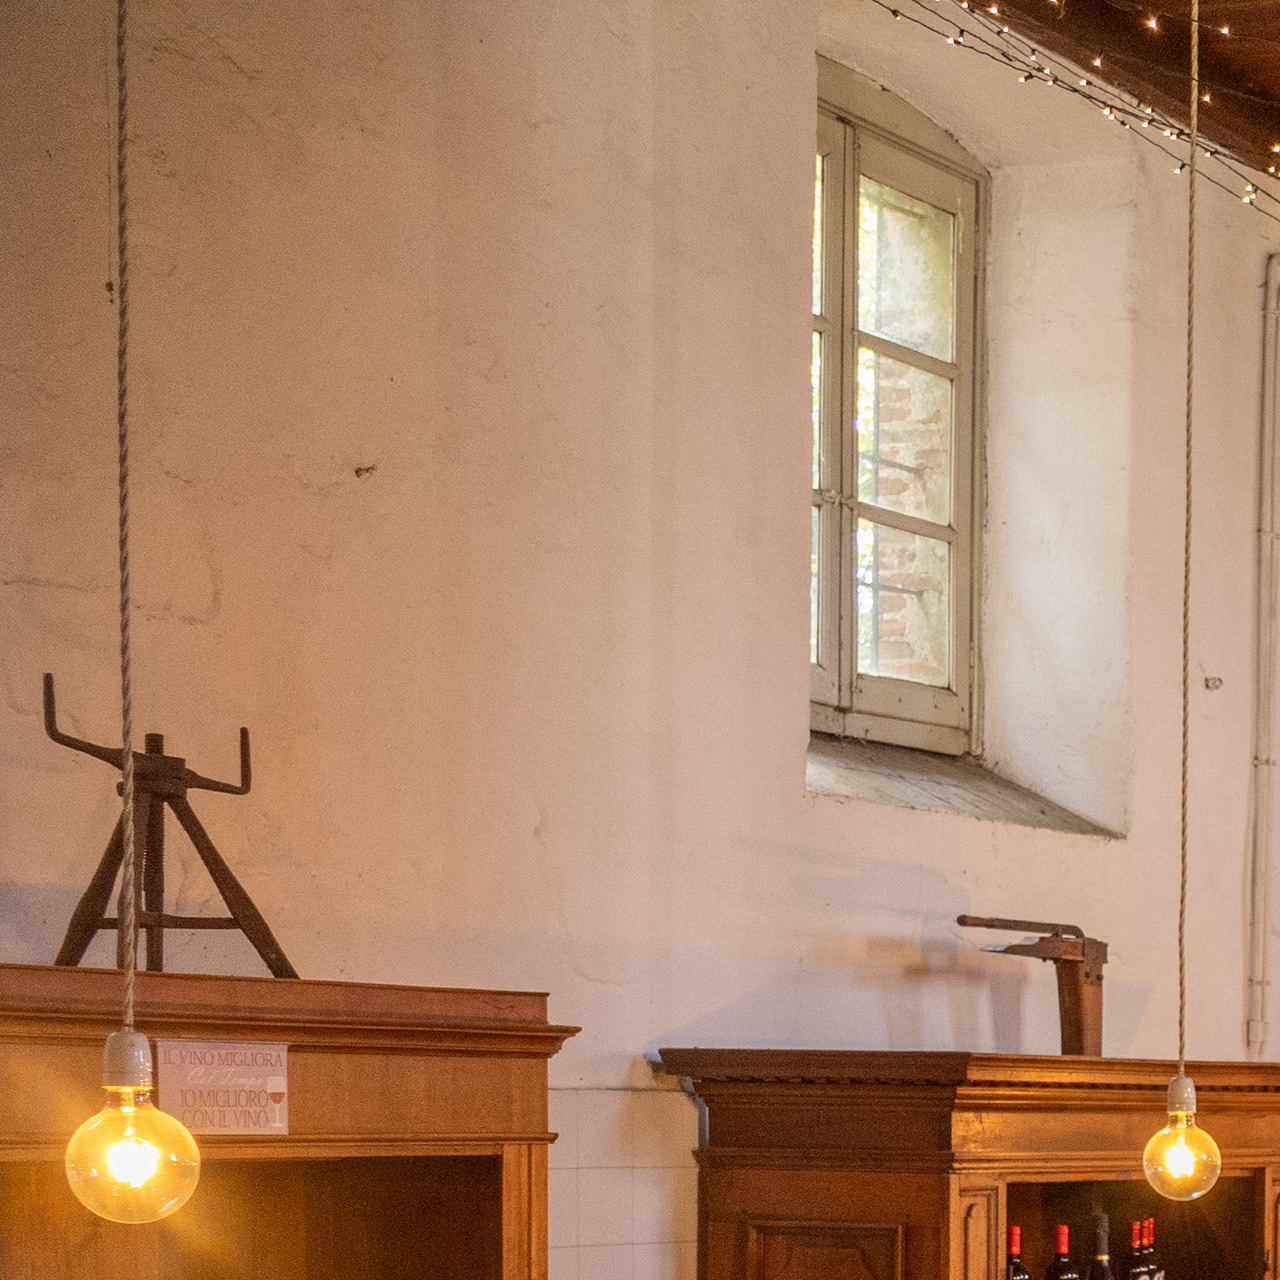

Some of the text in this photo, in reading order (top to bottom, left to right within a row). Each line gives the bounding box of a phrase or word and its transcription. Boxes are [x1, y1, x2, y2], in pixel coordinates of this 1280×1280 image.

[163, 1049, 283, 1067] IL VINO MIGLIORA
[180, 1089, 269, 1108] IO MIGLIORO
[182, 1109, 269, 1128] CON IL VINO
